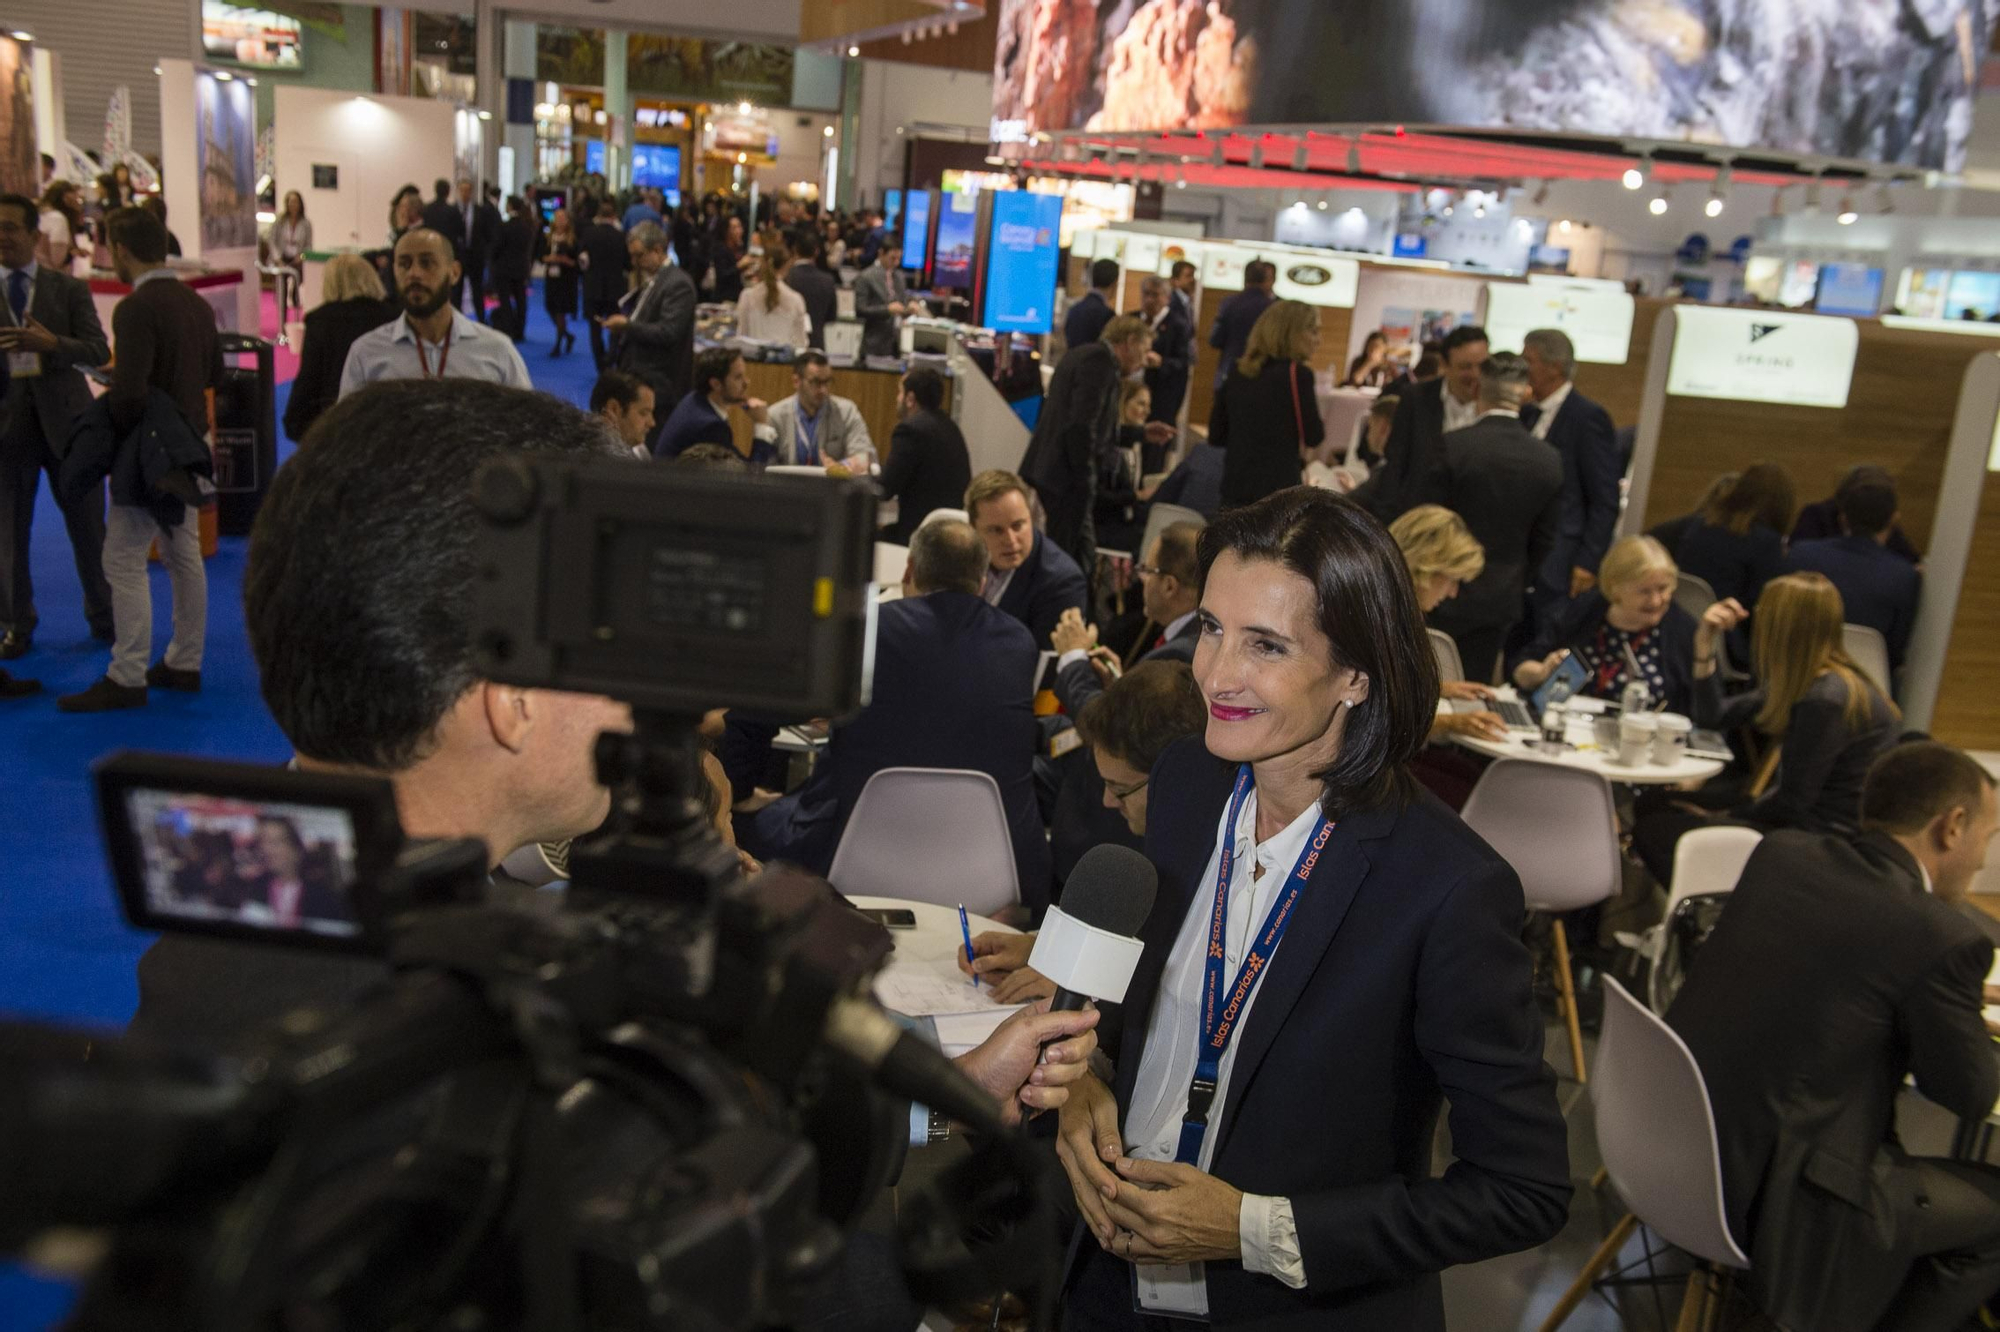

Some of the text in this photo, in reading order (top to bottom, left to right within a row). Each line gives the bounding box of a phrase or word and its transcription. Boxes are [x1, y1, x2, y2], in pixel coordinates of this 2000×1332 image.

[1213, 849, 1230, 940] Islas Canarias
[1297, 850, 1319, 880] Islas
[1264, 889, 1297, 946] www.canarias.es
[1210, 969, 1255, 1048] Islas Canarias
